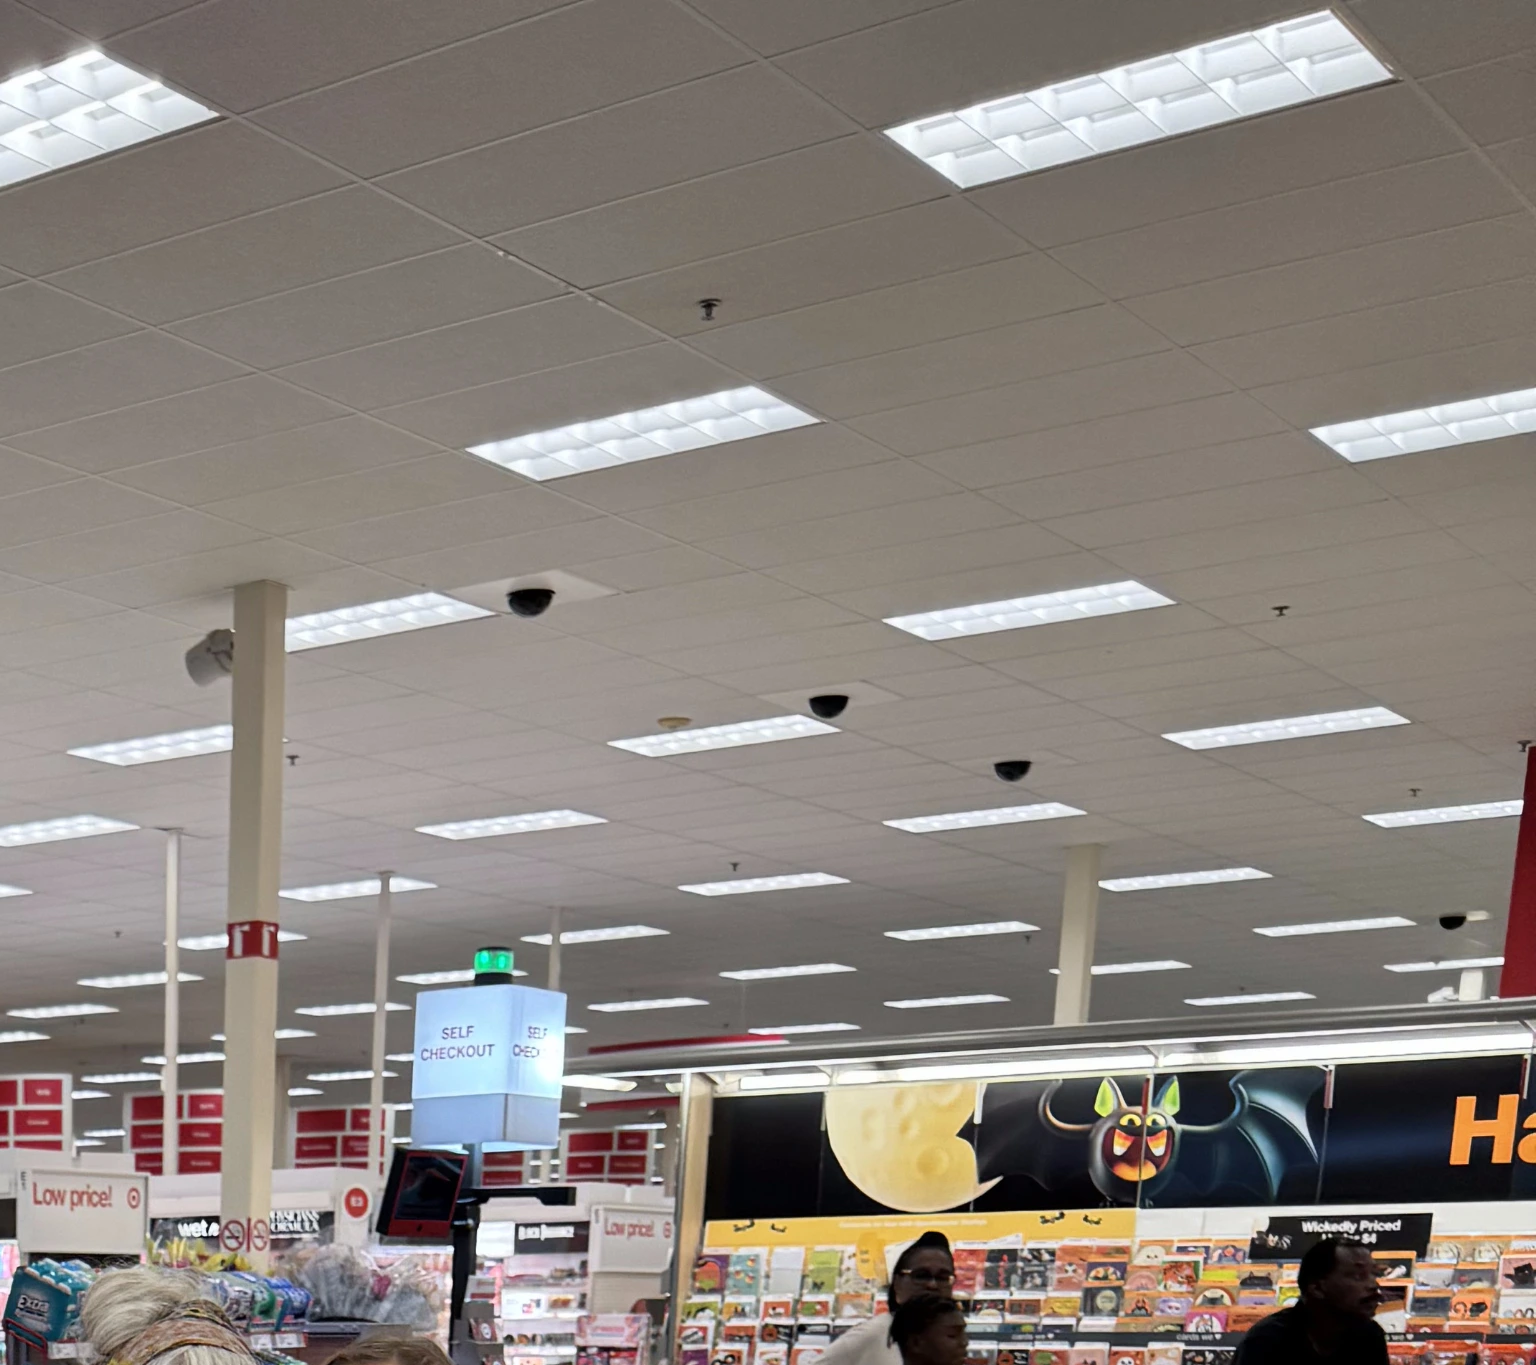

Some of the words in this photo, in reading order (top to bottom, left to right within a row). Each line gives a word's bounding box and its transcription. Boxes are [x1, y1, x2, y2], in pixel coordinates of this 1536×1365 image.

[441, 1026, 474, 1040] SELF
[421, 1044, 495, 1061] CHECKOUT
[32, 1182, 66, 1206] Low
[70, 1184, 113, 1212] price!
[177, 1219, 208, 1237] wet
[605, 1217, 625, 1237] Low
[1302, 1221, 1357, 1234] Wickedly
[1359, 1219, 1402, 1232] Priced
[18, 1294, 49, 1312] Extra
[1177, 1333, 1199, 1341] cards
